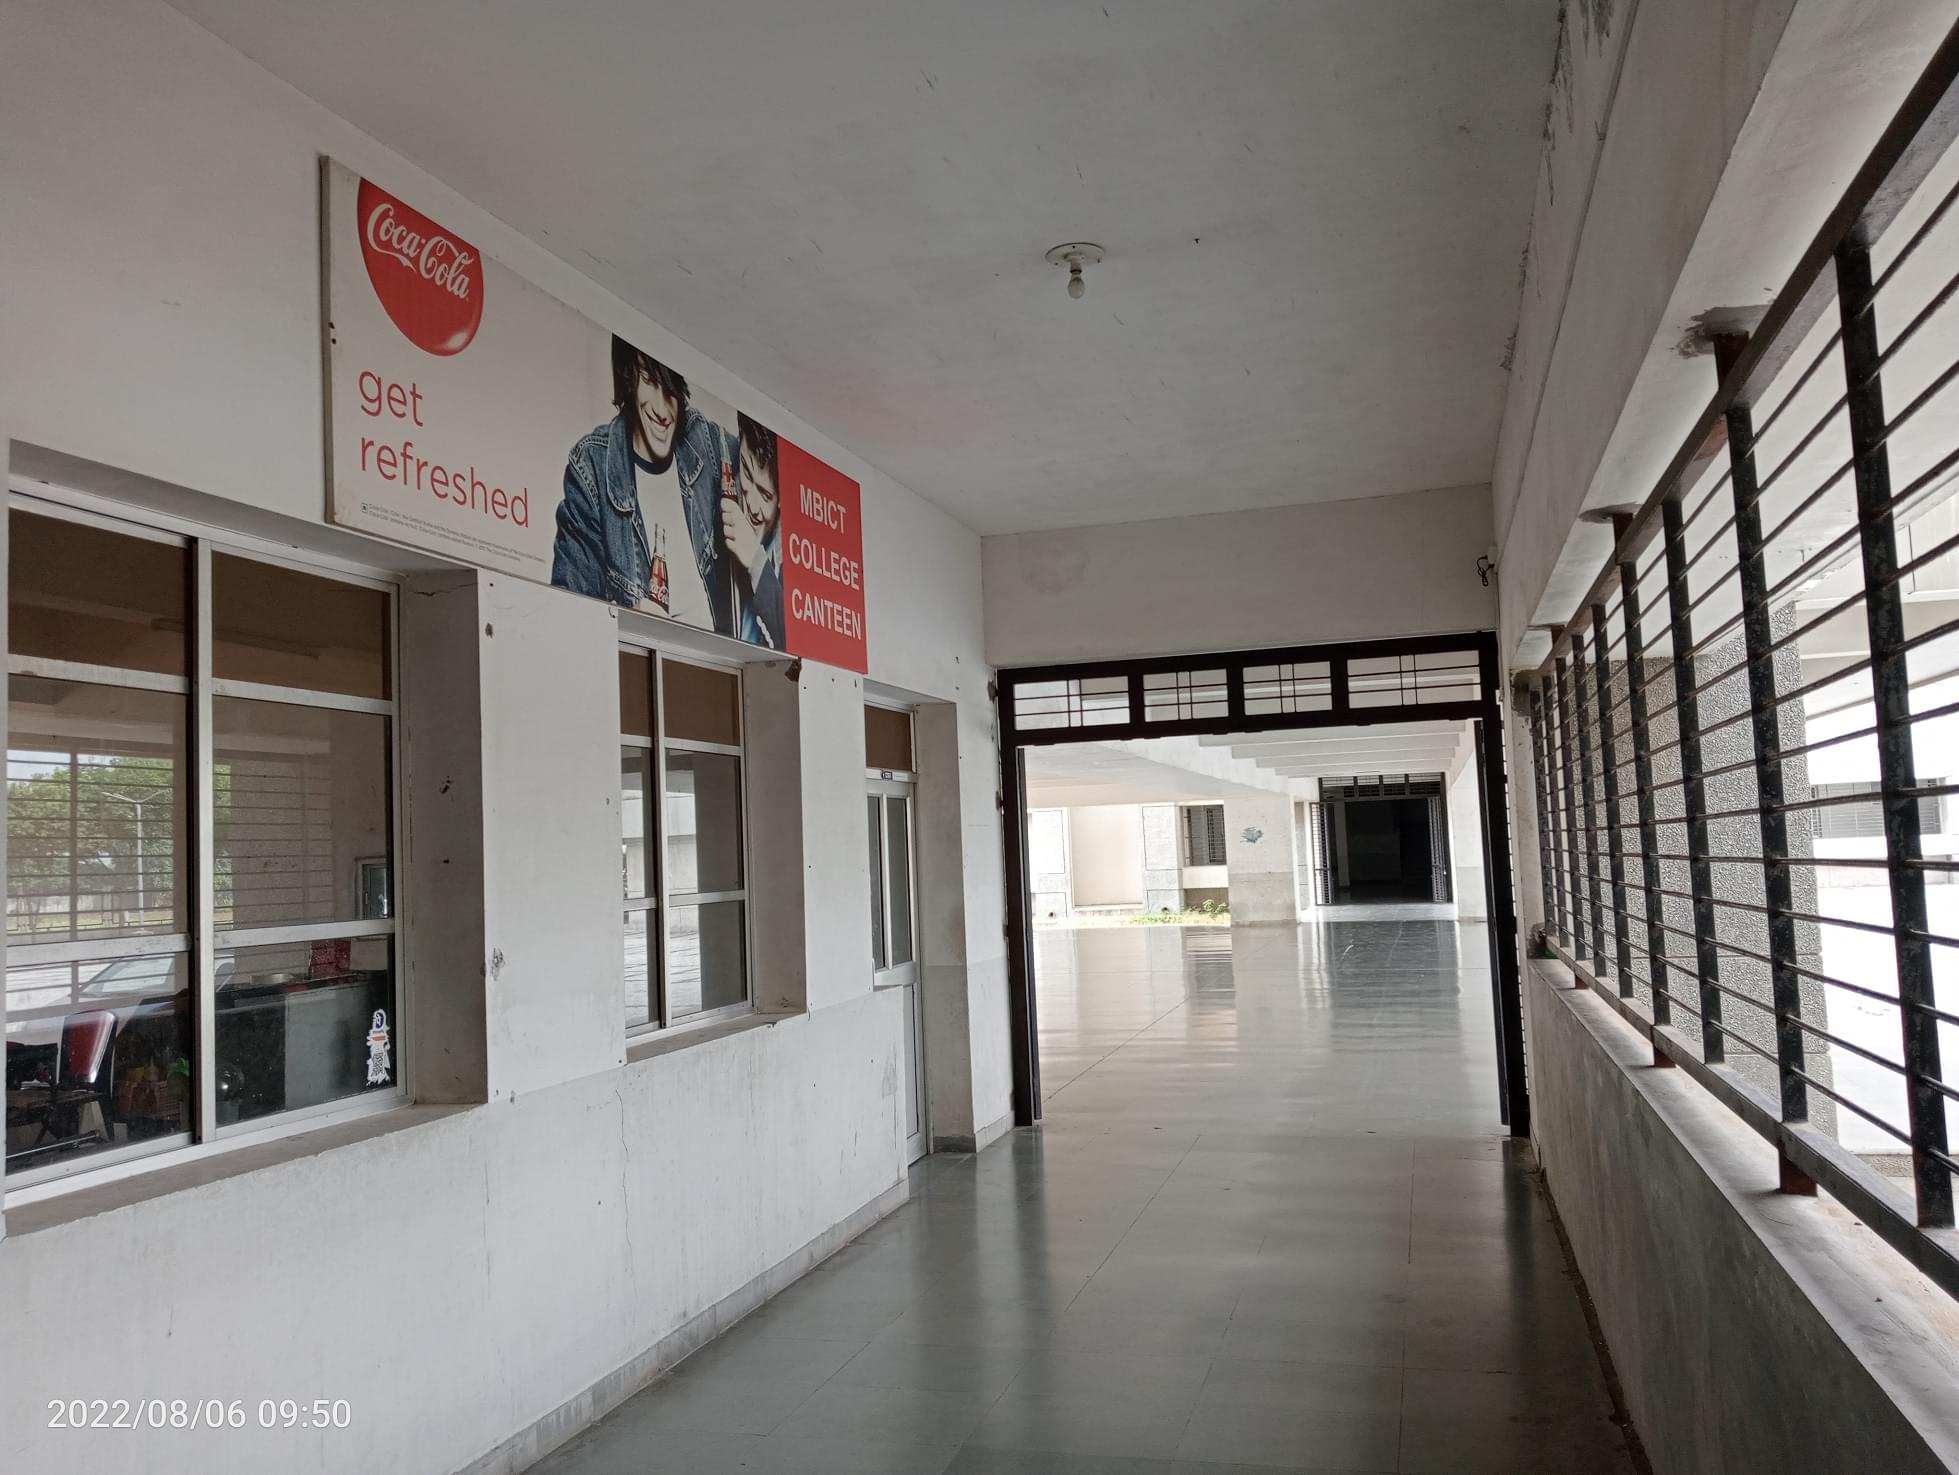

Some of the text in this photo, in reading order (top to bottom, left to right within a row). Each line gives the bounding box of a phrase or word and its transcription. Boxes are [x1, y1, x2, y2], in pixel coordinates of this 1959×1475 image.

[367, 203, 474, 301] Coca-Cola
[359, 370, 423, 427] get
[361, 438, 529, 528] refreshed
[799, 484, 846, 534] MBICT
[789, 534, 860, 590] COLLEGE
[791, 588, 862, 642] CANTEEN
